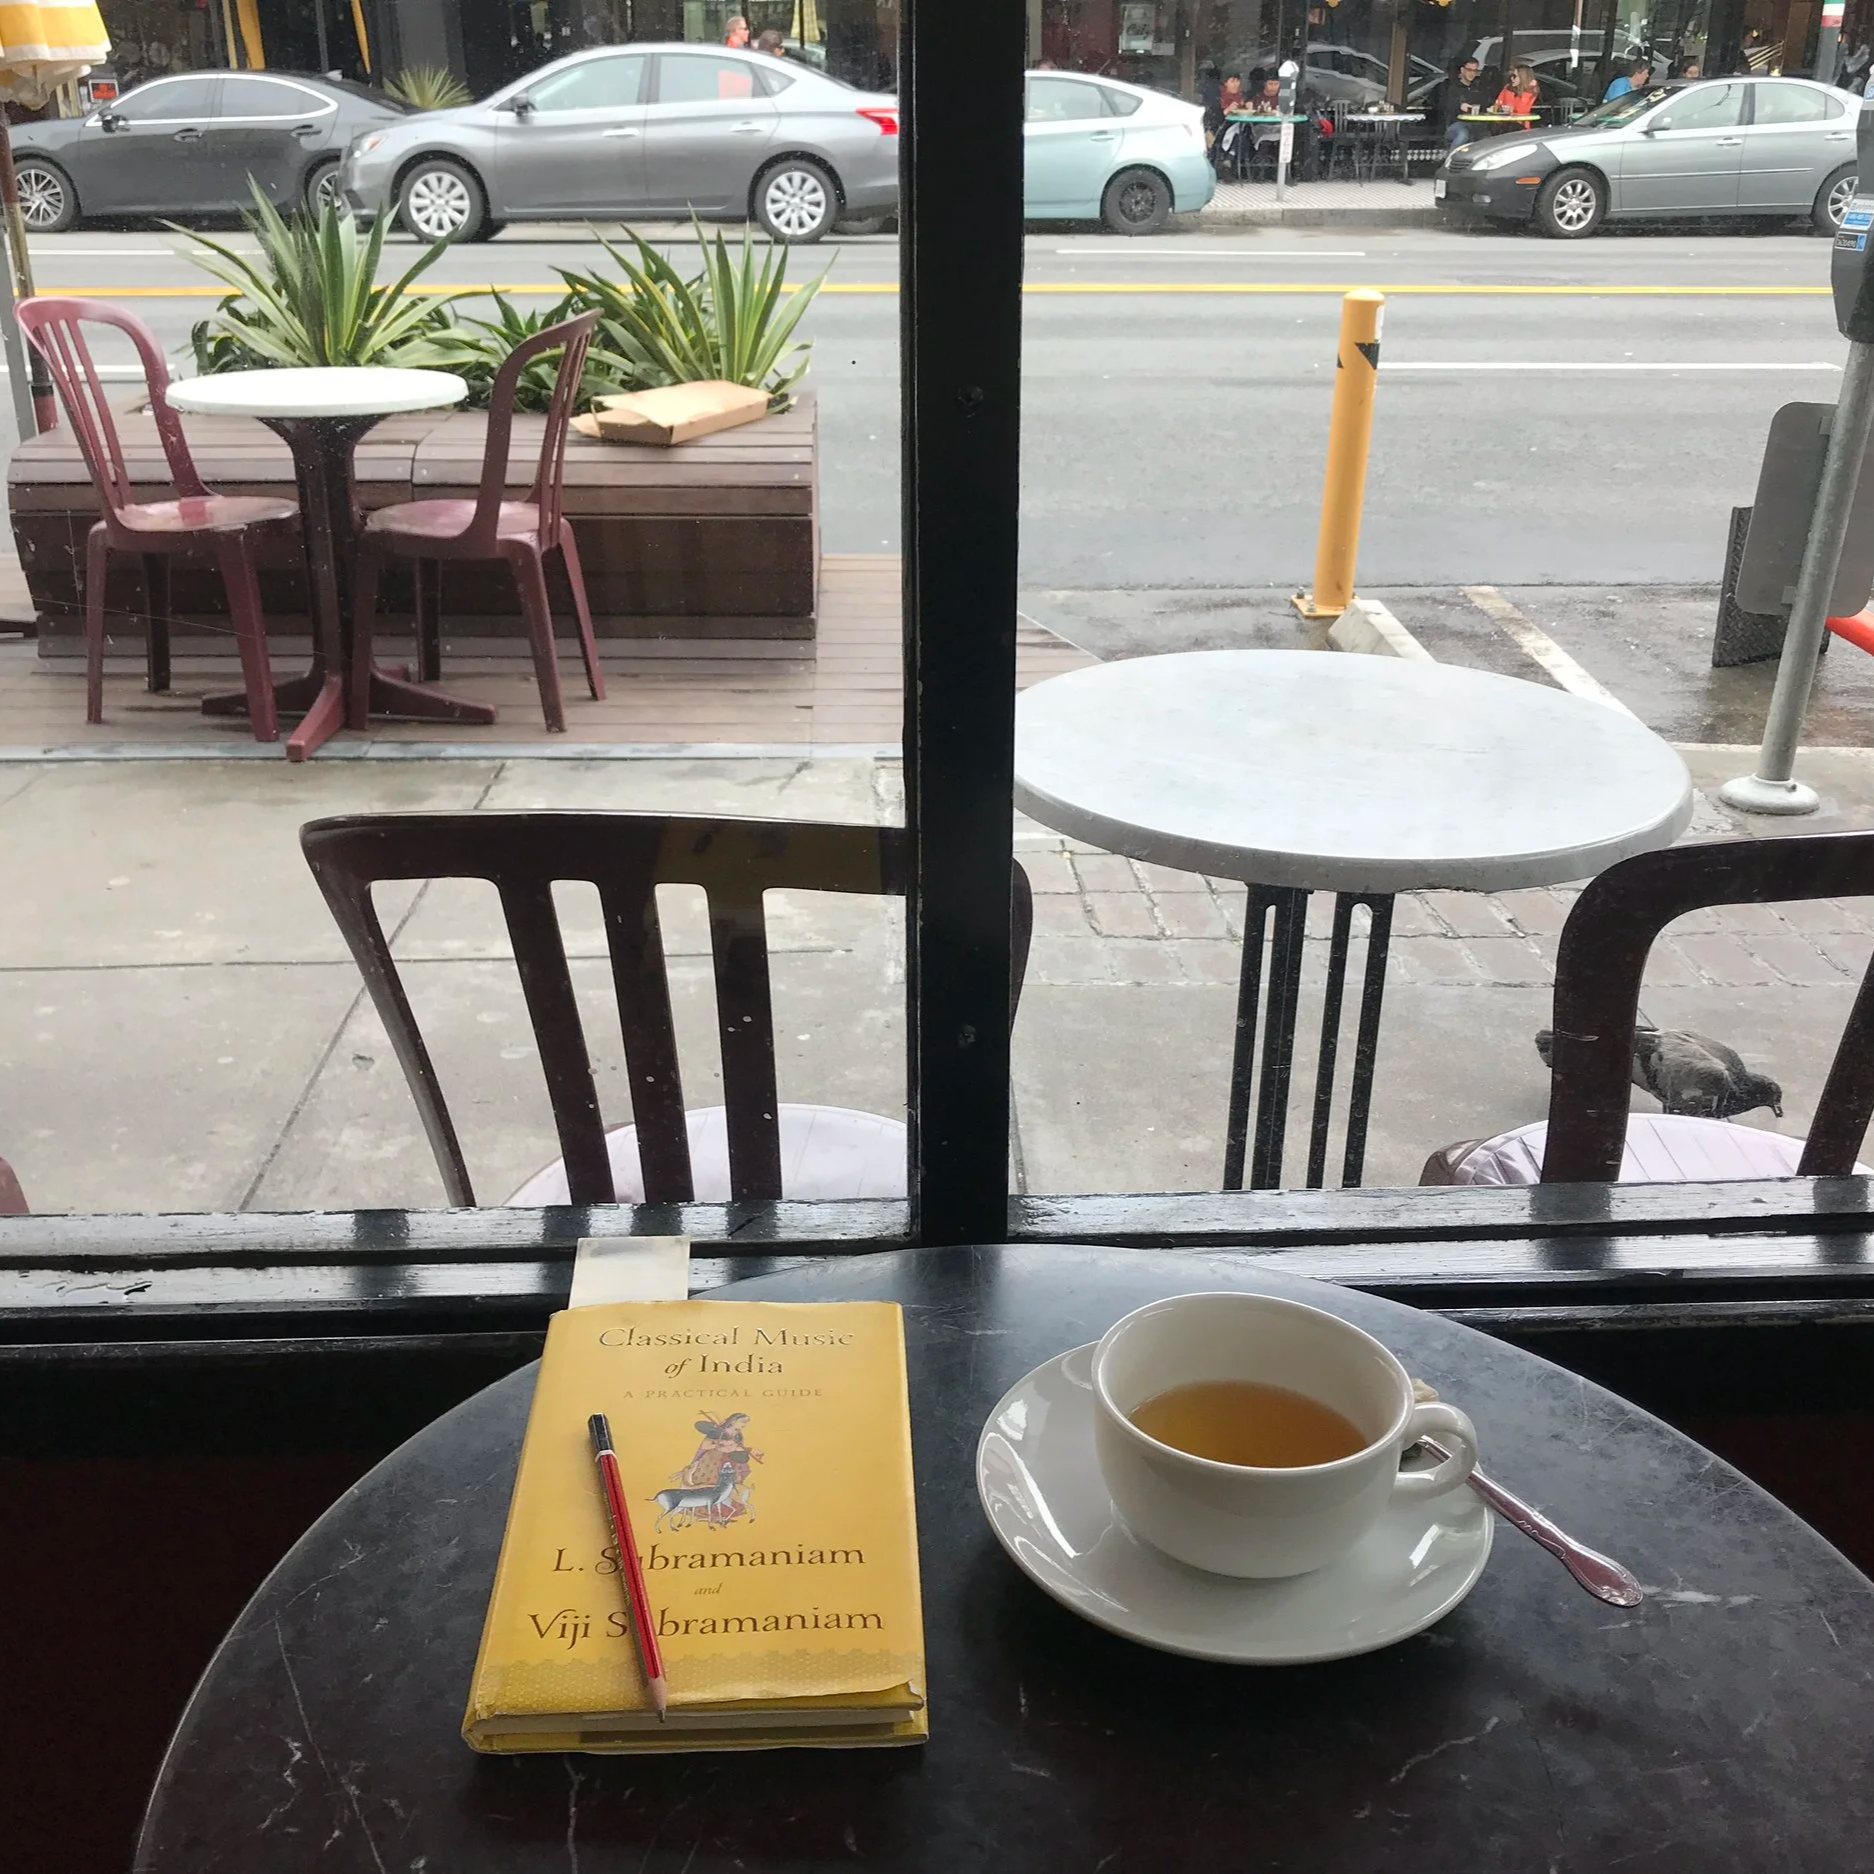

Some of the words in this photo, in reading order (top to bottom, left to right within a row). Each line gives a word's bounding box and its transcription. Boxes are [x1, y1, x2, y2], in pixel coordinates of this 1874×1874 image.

[598, 1325, 740, 1347] Classical
[753, 1327, 854, 1346] Music
[664, 1358, 693, 1379] of
[698, 1353, 784, 1374] India
[623, 1390, 634, 1399] A
[645, 1388, 752, 1399] PRACTICAL
[762, 1388, 824, 1398] GUIDE
[552, 1547, 585, 1573] L.
[693, 1582, 724, 1596] and
[526, 1608, 592, 1651] Viji
[605, 1606, 885, 1639] Sbramaniam
